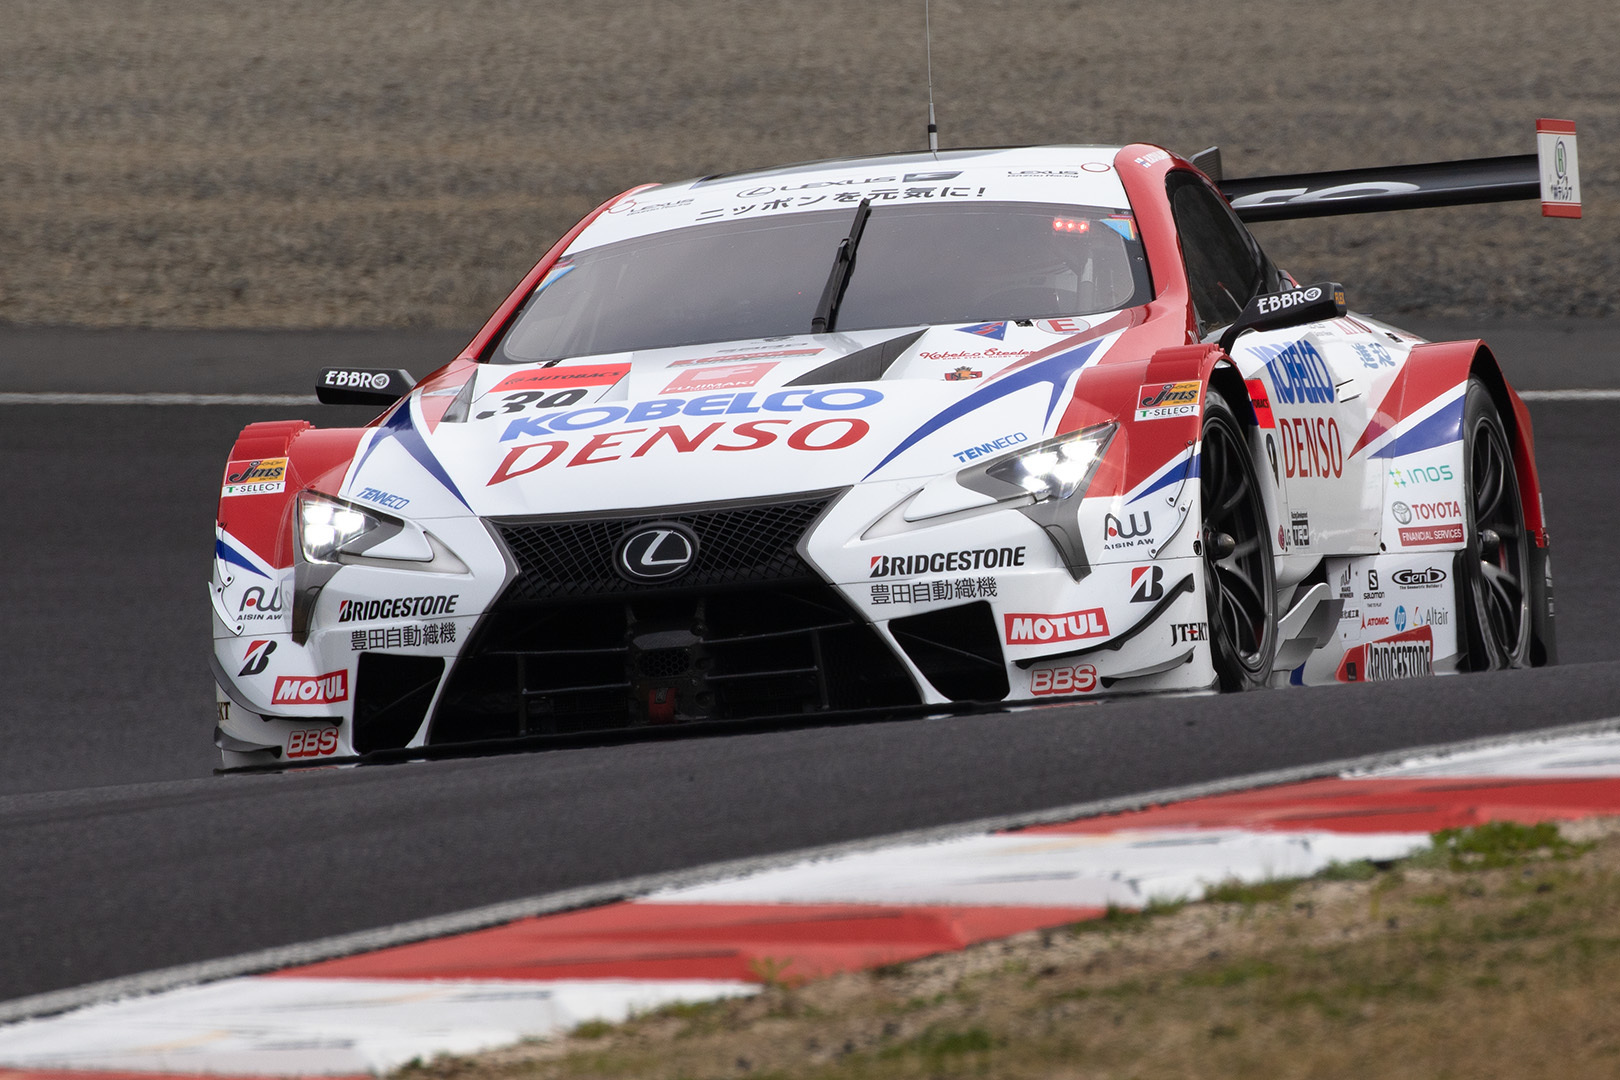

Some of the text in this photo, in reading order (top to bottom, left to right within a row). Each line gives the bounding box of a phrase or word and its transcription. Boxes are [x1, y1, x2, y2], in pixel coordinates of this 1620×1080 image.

[1257, 286, 1322, 315] EBBRO
[324, 371, 390, 389] EBBRO
[526, 370, 623, 383] AUTOBACS
[499, 389, 884, 443] KOBELCO
[1140, 405, 1195, 418] T-SELECT
[486, 418, 870, 486] DENSO
[953, 432, 1028, 463] TENNECO
[1279, 417, 1343, 479] DENSO
[227, 483, 281, 493] T-SELECT
[357, 487, 410, 510] TENNECO
[1412, 501, 1462, 520] TOYOTA
[1104, 542, 1134, 550] AISIN
[1402, 528, 1462, 541] FINANCIAL SERVICES
[870, 546, 1026, 578] BRIDGESTONE
[870, 576, 998, 605] 豊田自動織機
[339, 595, 459, 623] BRIDGESTONE
[1367, 616, 1389, 626] ATOMIC
[1426, 607, 1448, 625] Altair
[351, 622, 456, 651] 豊田自動織機
[1011, 615, 1103, 640] MOTUL
[276, 676, 345, 700] MOTUL
[1031, 664, 1097, 695] BBS
[287, 727, 338, 758] BBS
